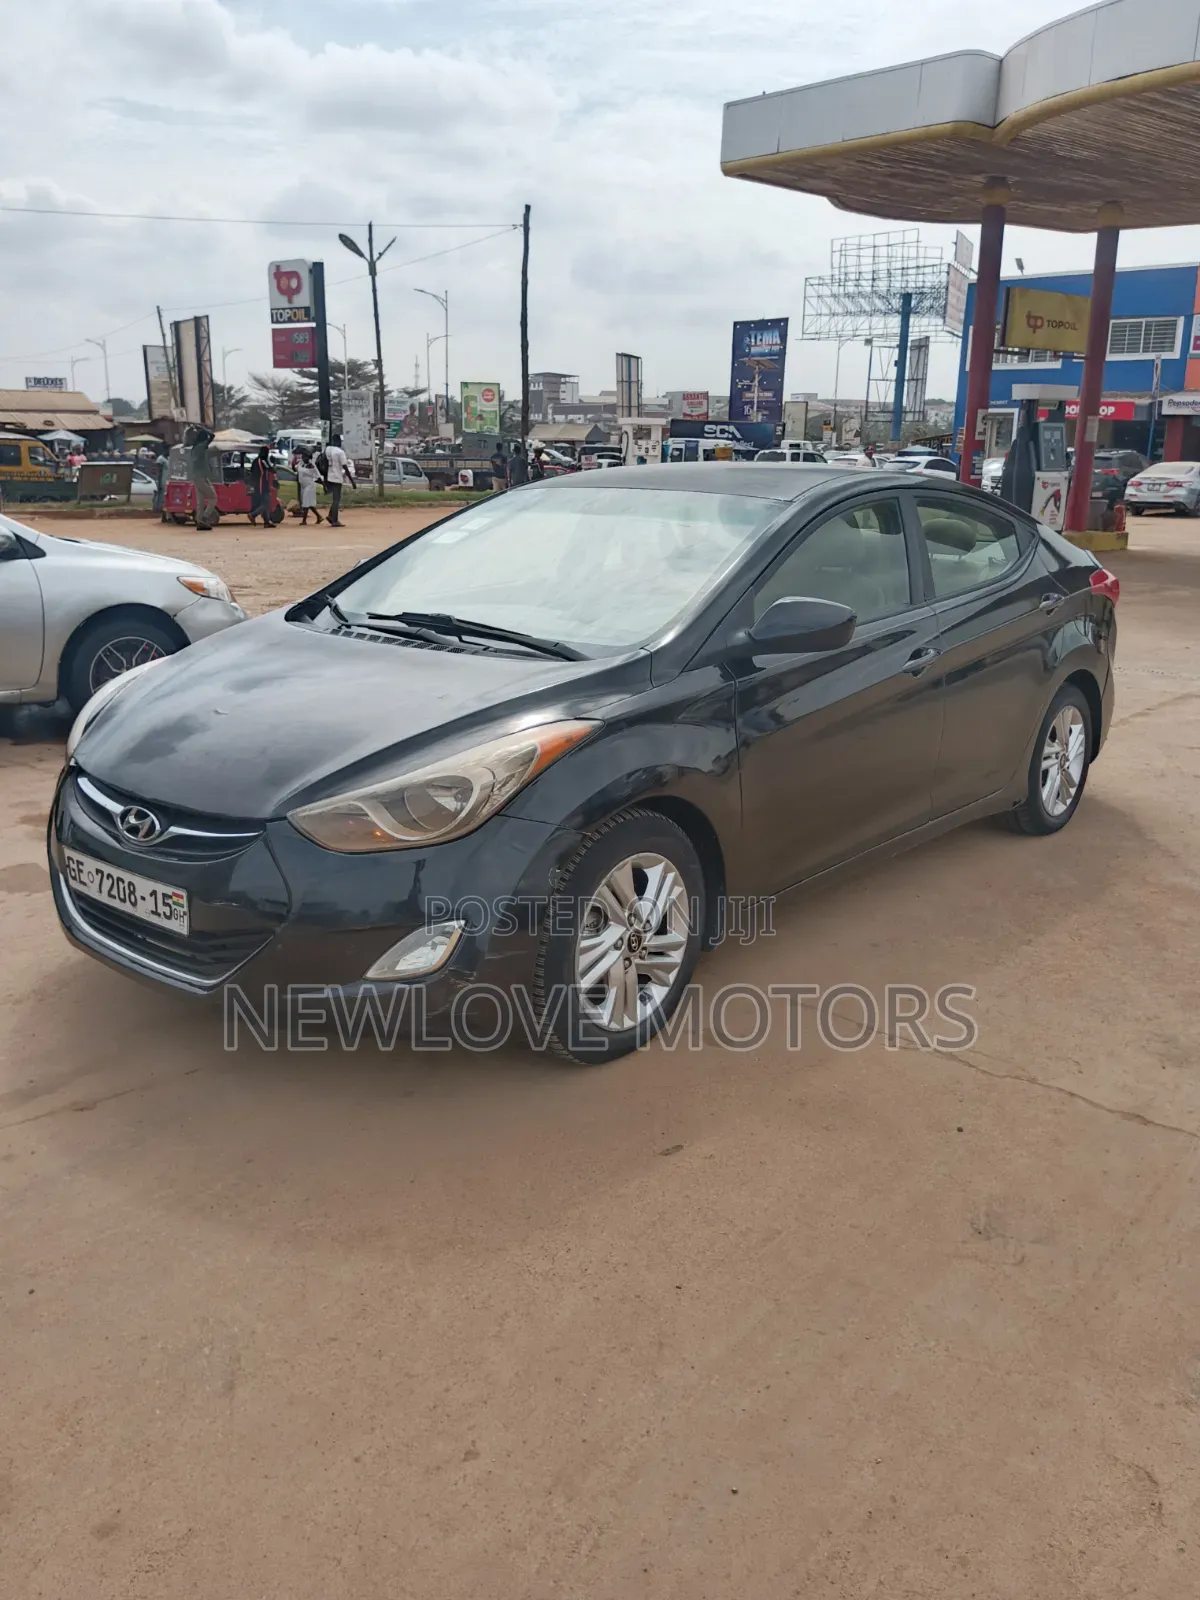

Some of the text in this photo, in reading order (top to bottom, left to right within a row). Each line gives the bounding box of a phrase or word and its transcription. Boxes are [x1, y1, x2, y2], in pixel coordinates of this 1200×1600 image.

[271, 308, 308, 322] TOPOIL
[1046, 319, 1078, 331] TOPOIL
[750, 329, 780, 345] TEMA
[66, 856, 87, 887] GE
